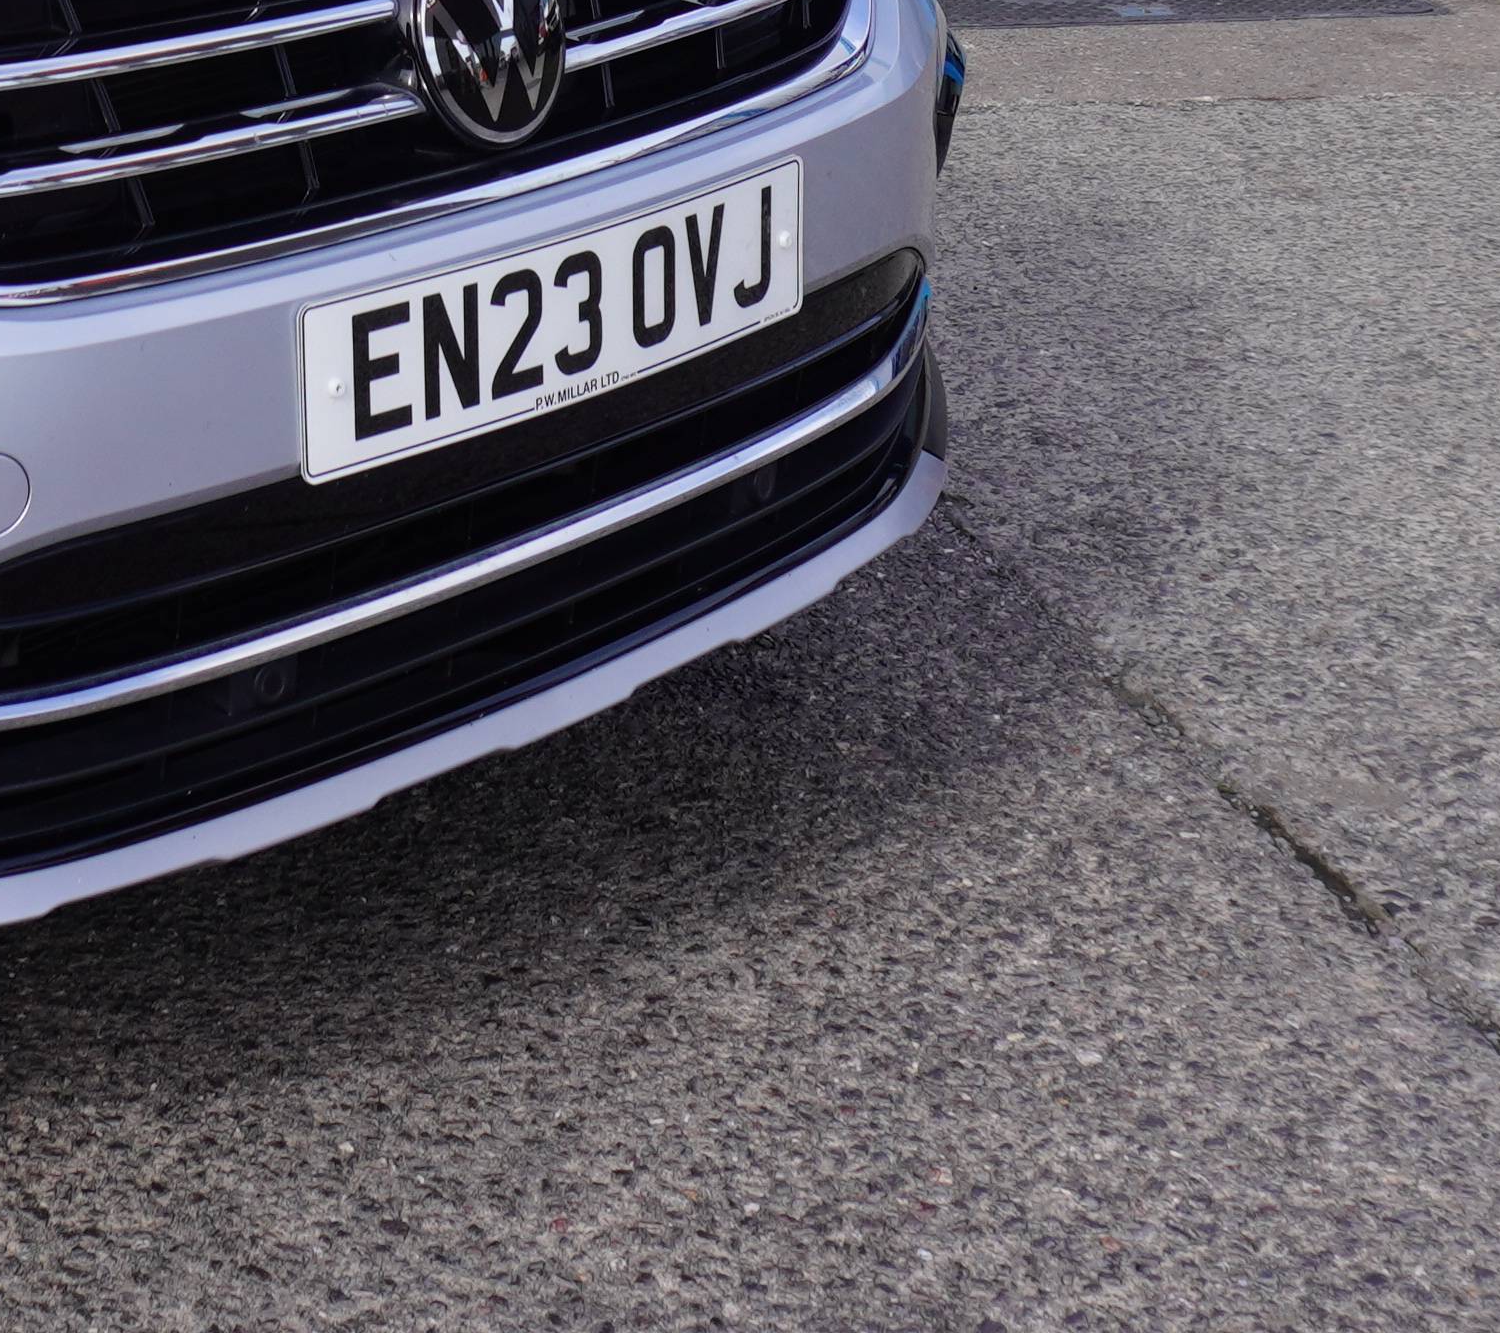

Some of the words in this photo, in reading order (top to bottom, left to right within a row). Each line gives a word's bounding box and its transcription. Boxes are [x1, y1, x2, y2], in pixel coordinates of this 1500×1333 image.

[351, 249, 603, 442] EN23
[631, 184, 773, 349] OVJ
[600, 370, 621, 389] LTD
